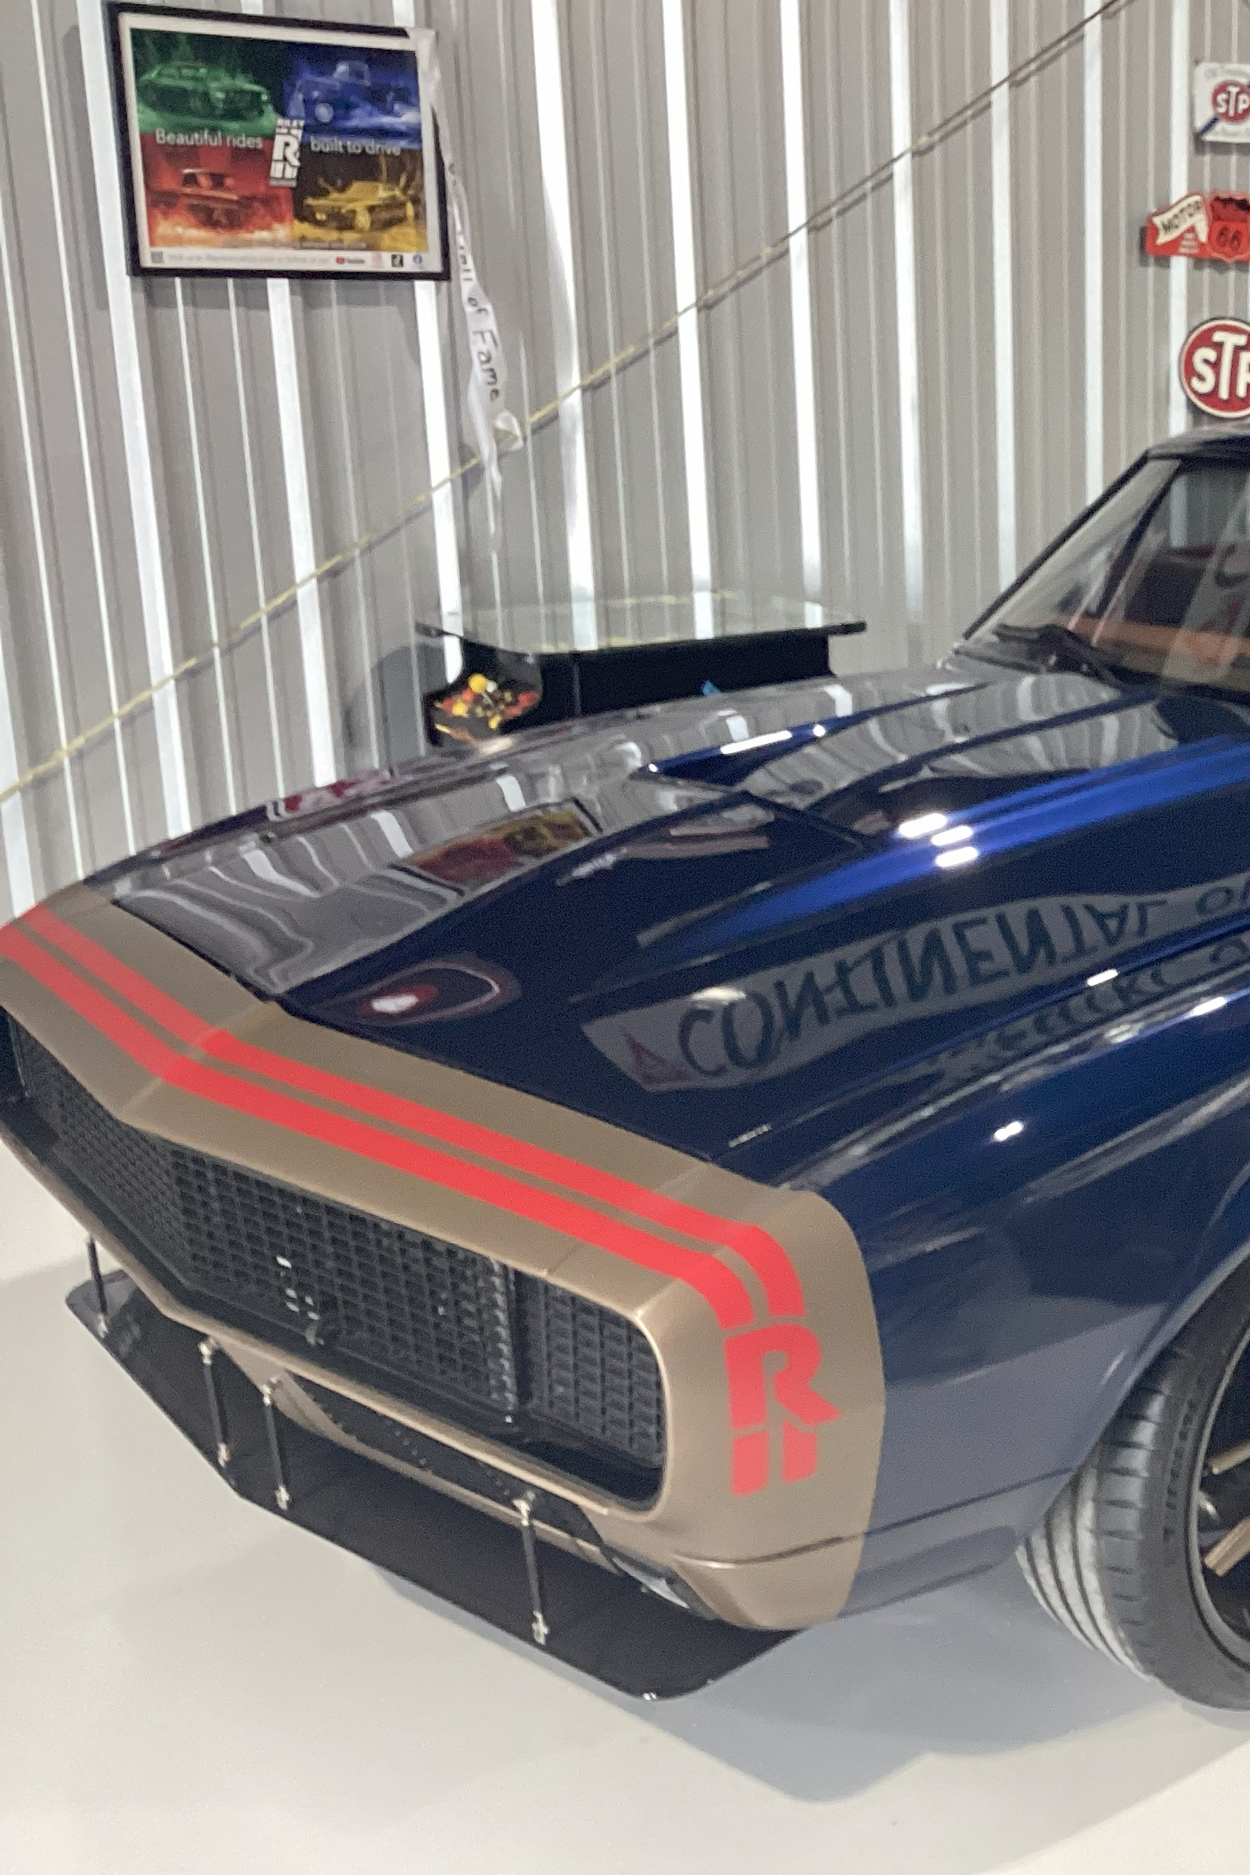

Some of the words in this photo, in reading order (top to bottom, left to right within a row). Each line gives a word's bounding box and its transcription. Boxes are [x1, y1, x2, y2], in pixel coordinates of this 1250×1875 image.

[1216, 86, 1250, 117] STP
[155, 128, 222, 147] Beautiful
[226, 134, 263, 149] rides
[310, 136, 344, 153] built
[346, 142, 363, 154] to
[365, 138, 402, 156] drive
[1161, 199, 1202, 234] MOTOR
[1215, 225, 1242, 251] 66
[467, 296, 489, 316] of
[472, 329, 500, 401] Fame
